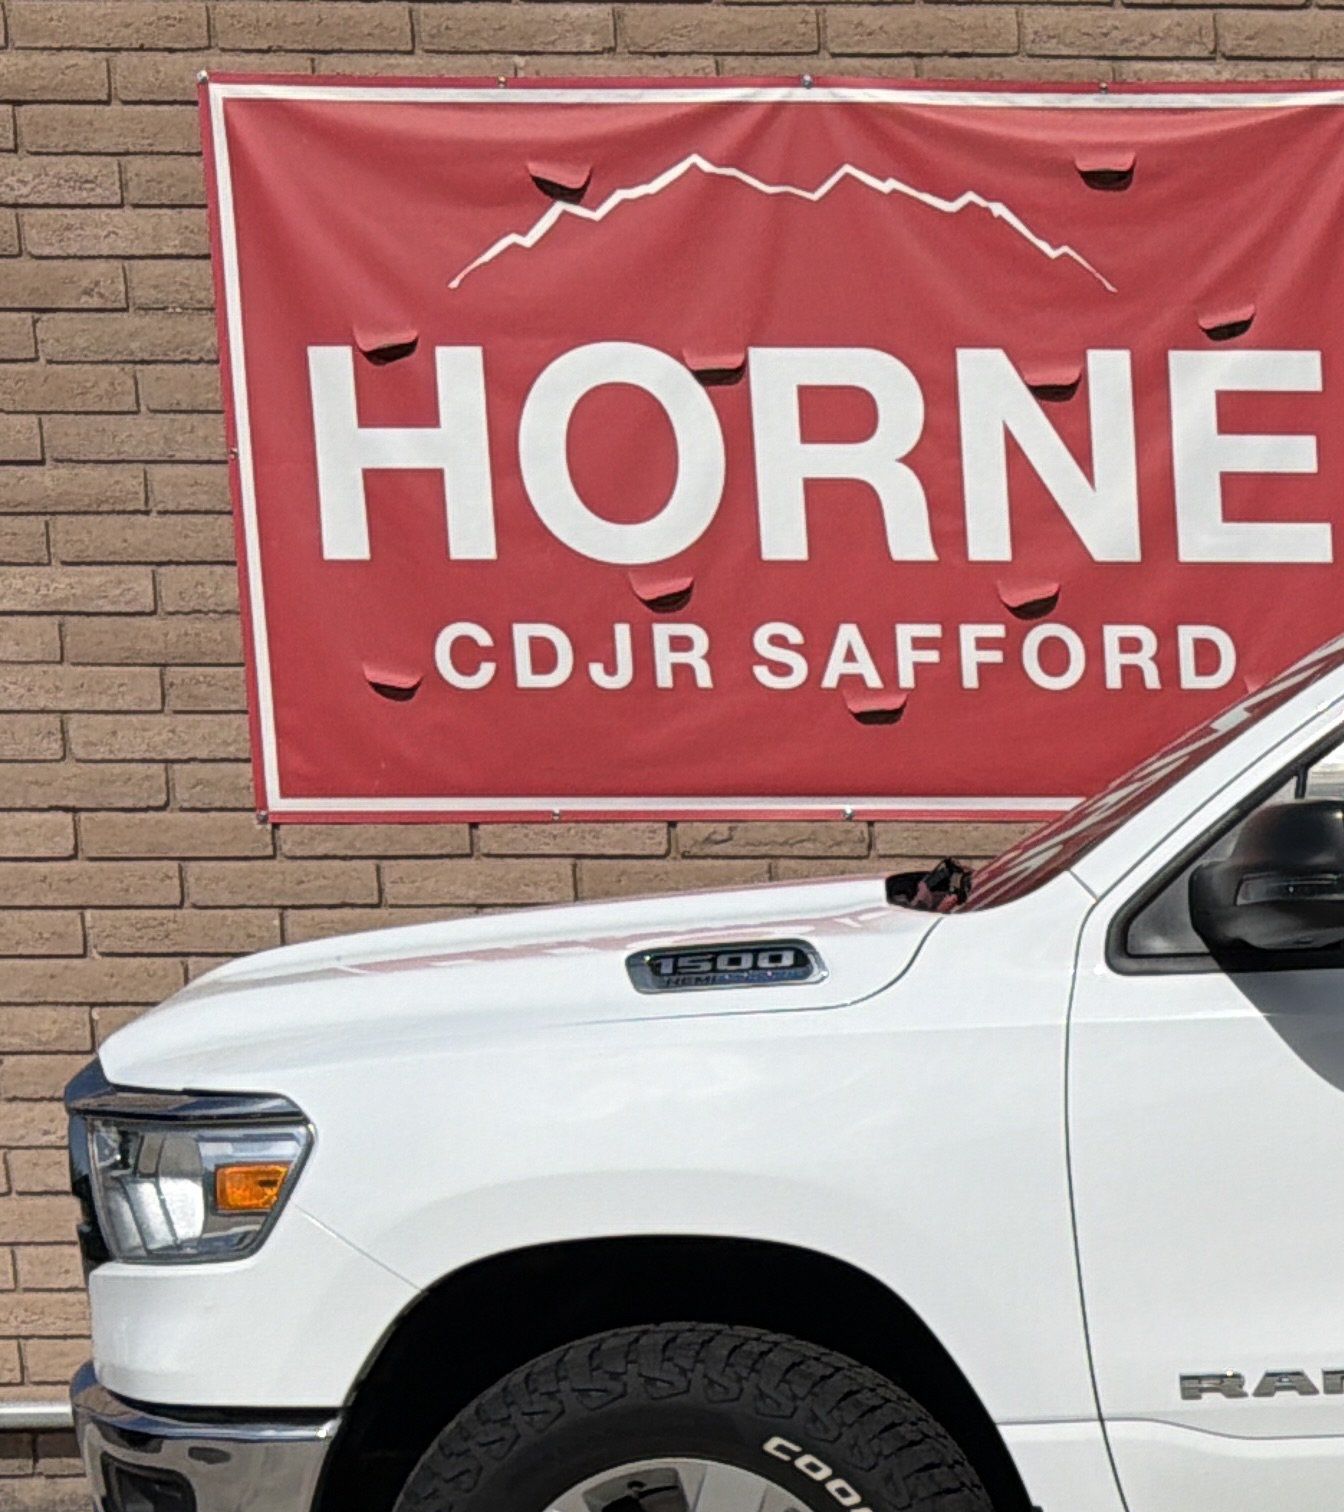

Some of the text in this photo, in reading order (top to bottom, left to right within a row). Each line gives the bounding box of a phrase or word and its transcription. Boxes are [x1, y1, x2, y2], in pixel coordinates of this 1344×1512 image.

[307, 342, 1333, 564] HORNE
[435, 622, 1236, 690] CDJR SAFFORD
[659, 951, 795, 975] 1500
